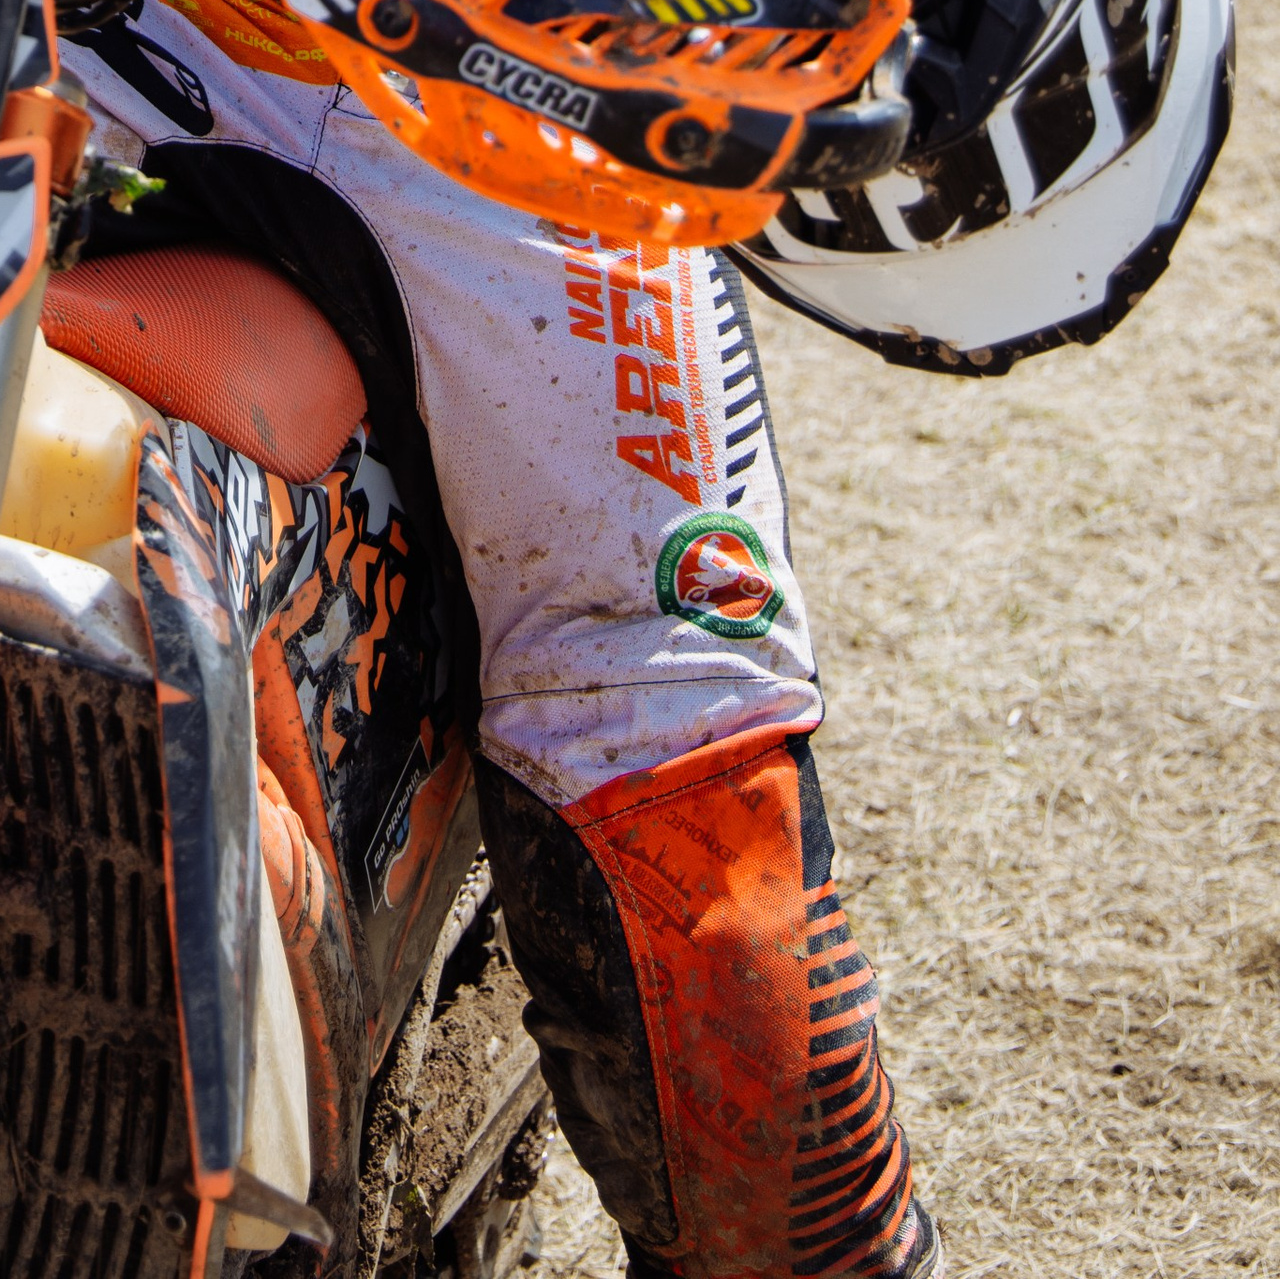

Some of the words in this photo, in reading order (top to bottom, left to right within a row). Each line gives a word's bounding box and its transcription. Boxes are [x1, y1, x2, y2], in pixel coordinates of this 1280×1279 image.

[458, 42, 600, 133] CYCRA
[678, 261, 694, 307] ВИДОВ
[606, 235, 702, 506] AREN
[681, 309, 705, 409] ТЕХНИЧЕСКИХ
[693, 412, 718, 484] СТАДИОН
[369, 842, 391, 869] Go
[384, 768, 422, 842] PROshin
